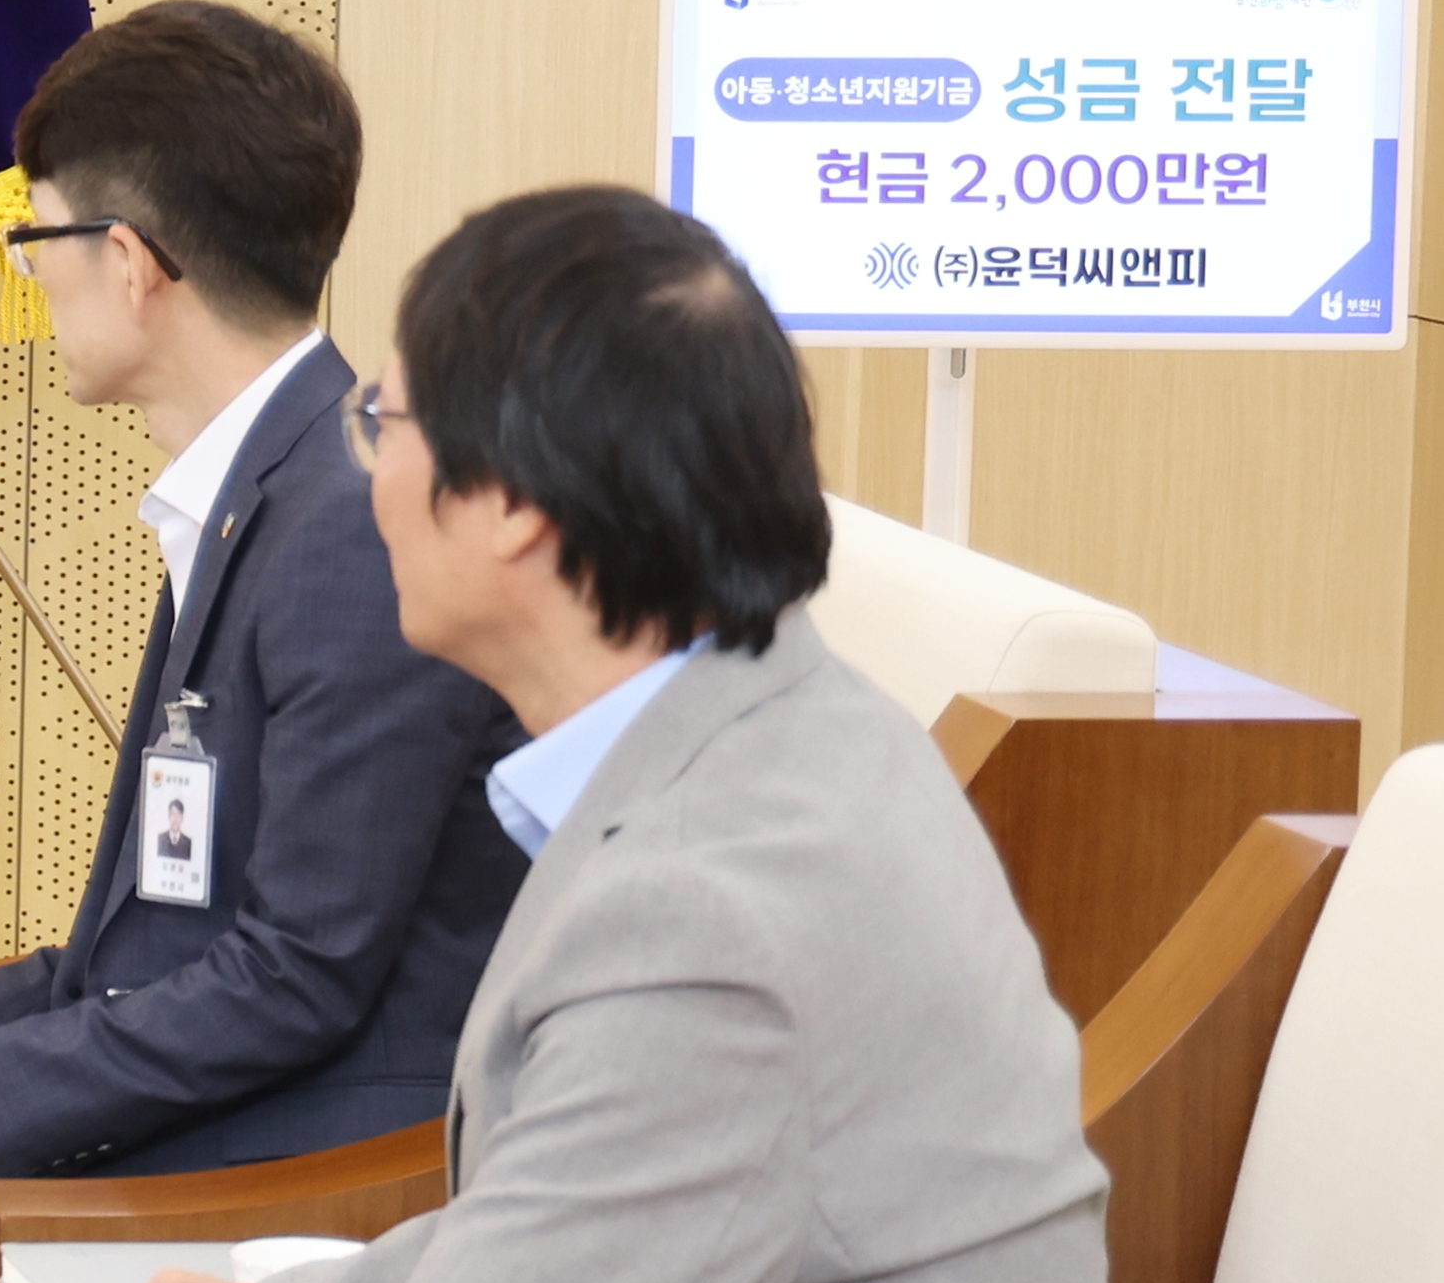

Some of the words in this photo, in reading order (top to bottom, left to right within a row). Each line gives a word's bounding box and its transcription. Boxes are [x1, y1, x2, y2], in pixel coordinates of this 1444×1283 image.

[1001, 57, 1141, 123] 성금
[1170, 57, 1314, 123] 전달
[816, 148, 929, 204] 현금
[949, 151, 1269, 212] 2,000만원
